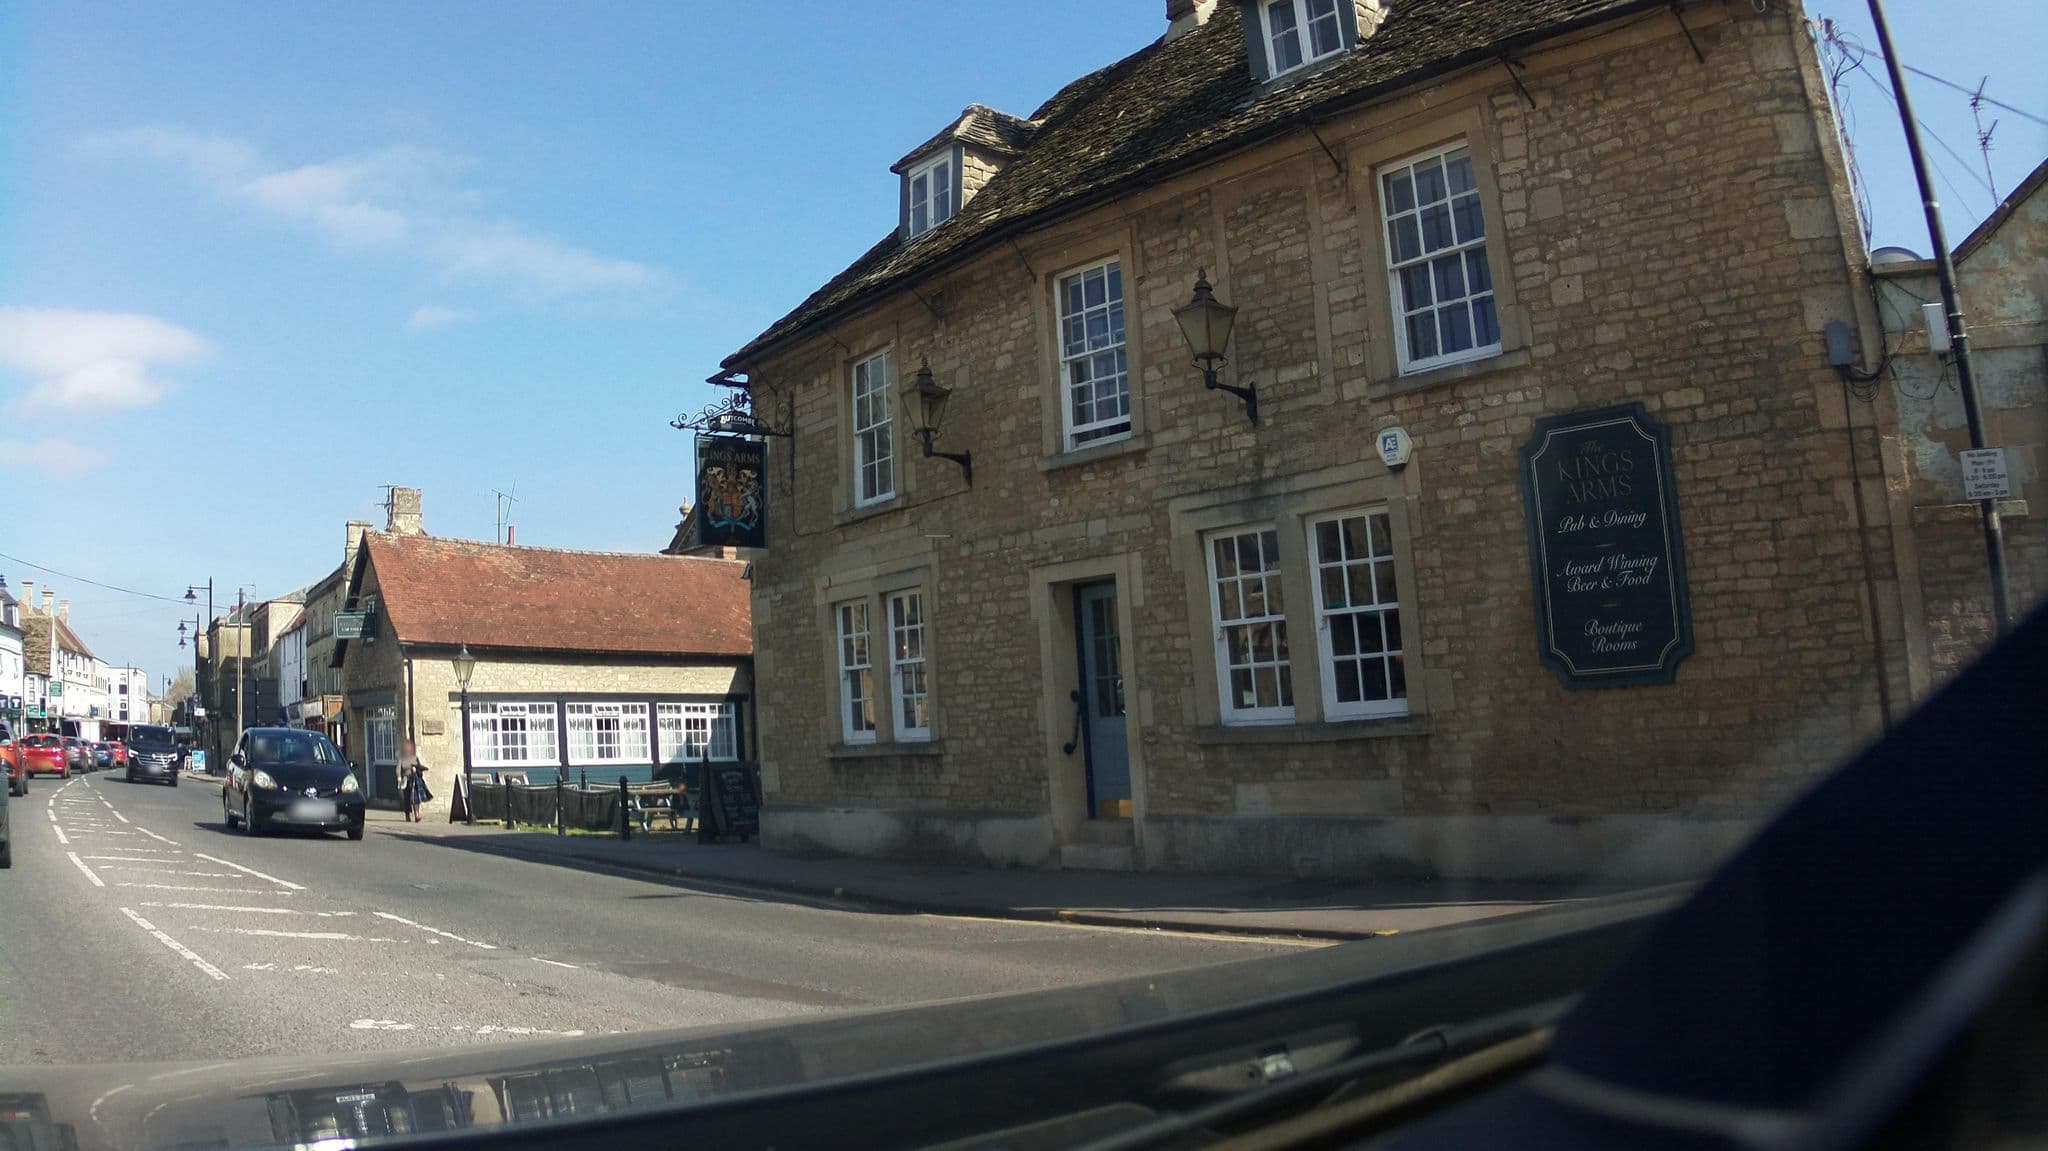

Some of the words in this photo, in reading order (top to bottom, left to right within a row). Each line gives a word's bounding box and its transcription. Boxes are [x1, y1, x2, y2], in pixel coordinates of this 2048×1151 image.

[735, 453, 761, 466] ARMS
[1556, 450, 1633, 481] KINGS
[1567, 475, 1633, 504] ARMS
[1557, 514, 1585, 534] Pub
[1588, 515, 1601, 529] &
[1603, 508, 1649, 529] Dining
[1556, 556, 1604, 578] Award
[1607, 553, 1659, 574] Winning
[1567, 576, 1598, 593] Beer
[1601, 575, 1614, 589] &
[1616, 569, 1654, 588] Food
[1584, 618, 1645, 640] Boutique
[1591, 635, 1639, 654] Rooms
